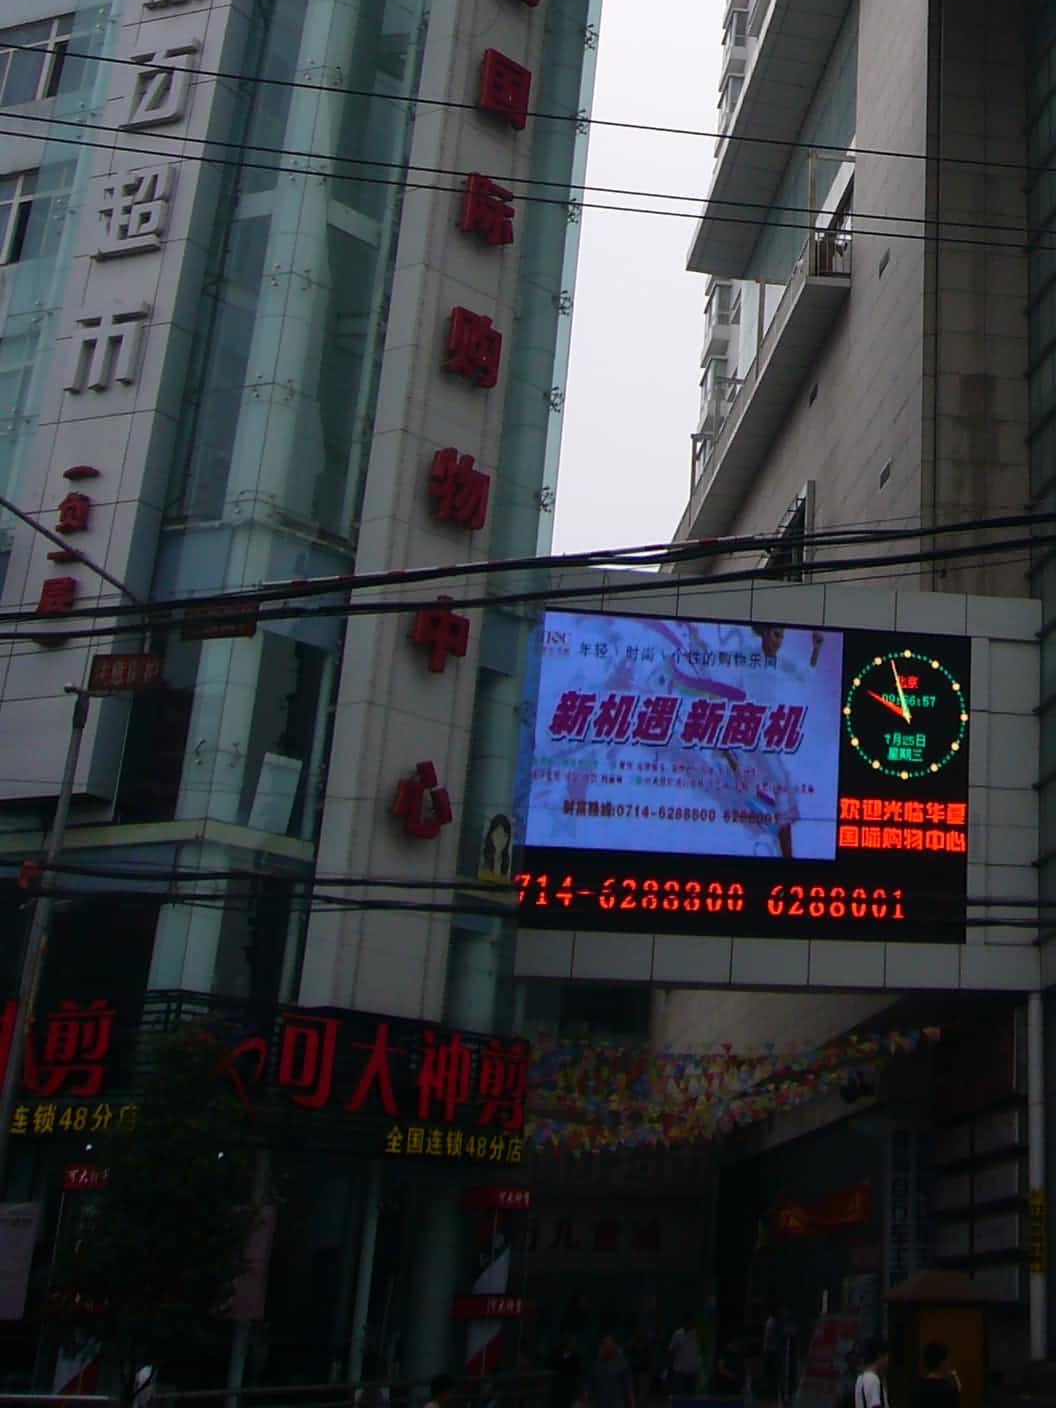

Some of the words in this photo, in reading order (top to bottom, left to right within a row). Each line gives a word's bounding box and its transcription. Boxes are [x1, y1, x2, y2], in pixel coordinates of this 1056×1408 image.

[549, 690, 678, 748] 新机遇
[680, 699, 808, 754] 新商机
[888, 747, 925, 762] 星期三
[839, 798, 968, 825] 欢迎光临华夏
[838, 826, 968, 853] 国际购物中心
[767, 884, 905, 920] 6288001
[385, 1125, 523, 1165] 全国连锁48分店
